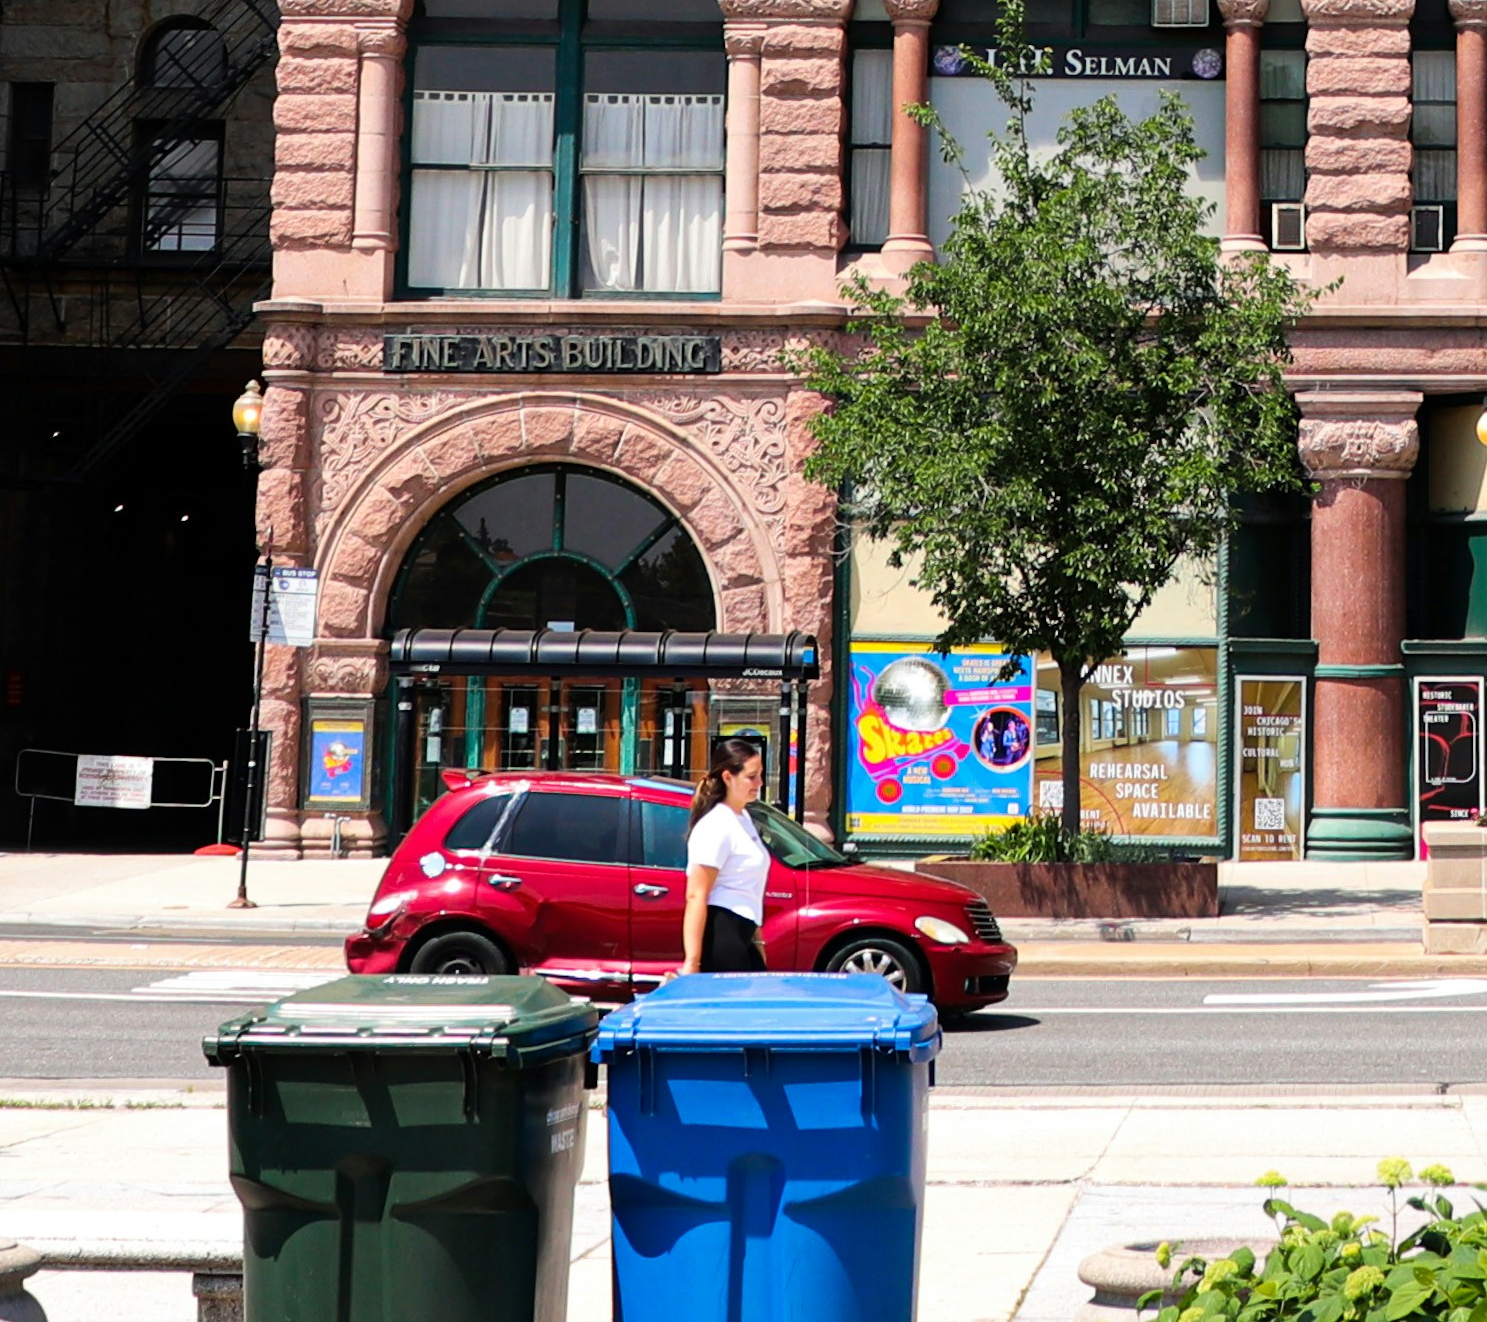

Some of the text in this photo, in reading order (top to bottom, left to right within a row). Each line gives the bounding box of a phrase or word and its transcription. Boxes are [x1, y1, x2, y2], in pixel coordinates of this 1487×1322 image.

[1065, 49, 1172, 76] SELMAN
[392, 336, 707, 370] FINE ARTS BUILDING
[1112, 690, 1185, 709] STUDIOS
[1244, 705, 1263, 715] JOIN
[858, 714, 953, 764] Skates
[1247, 727, 1285, 736] HISTORIC
[1243, 748, 1279, 757] CULTURAL
[1090, 763, 1168, 780] REHEARSAL
[1116, 783, 1158, 799] SPACE
[1133, 803, 1211, 819] AVAILABLE
[1242, 834, 1262, 843] SCAN
[1265, 834, 1275, 843] TO
